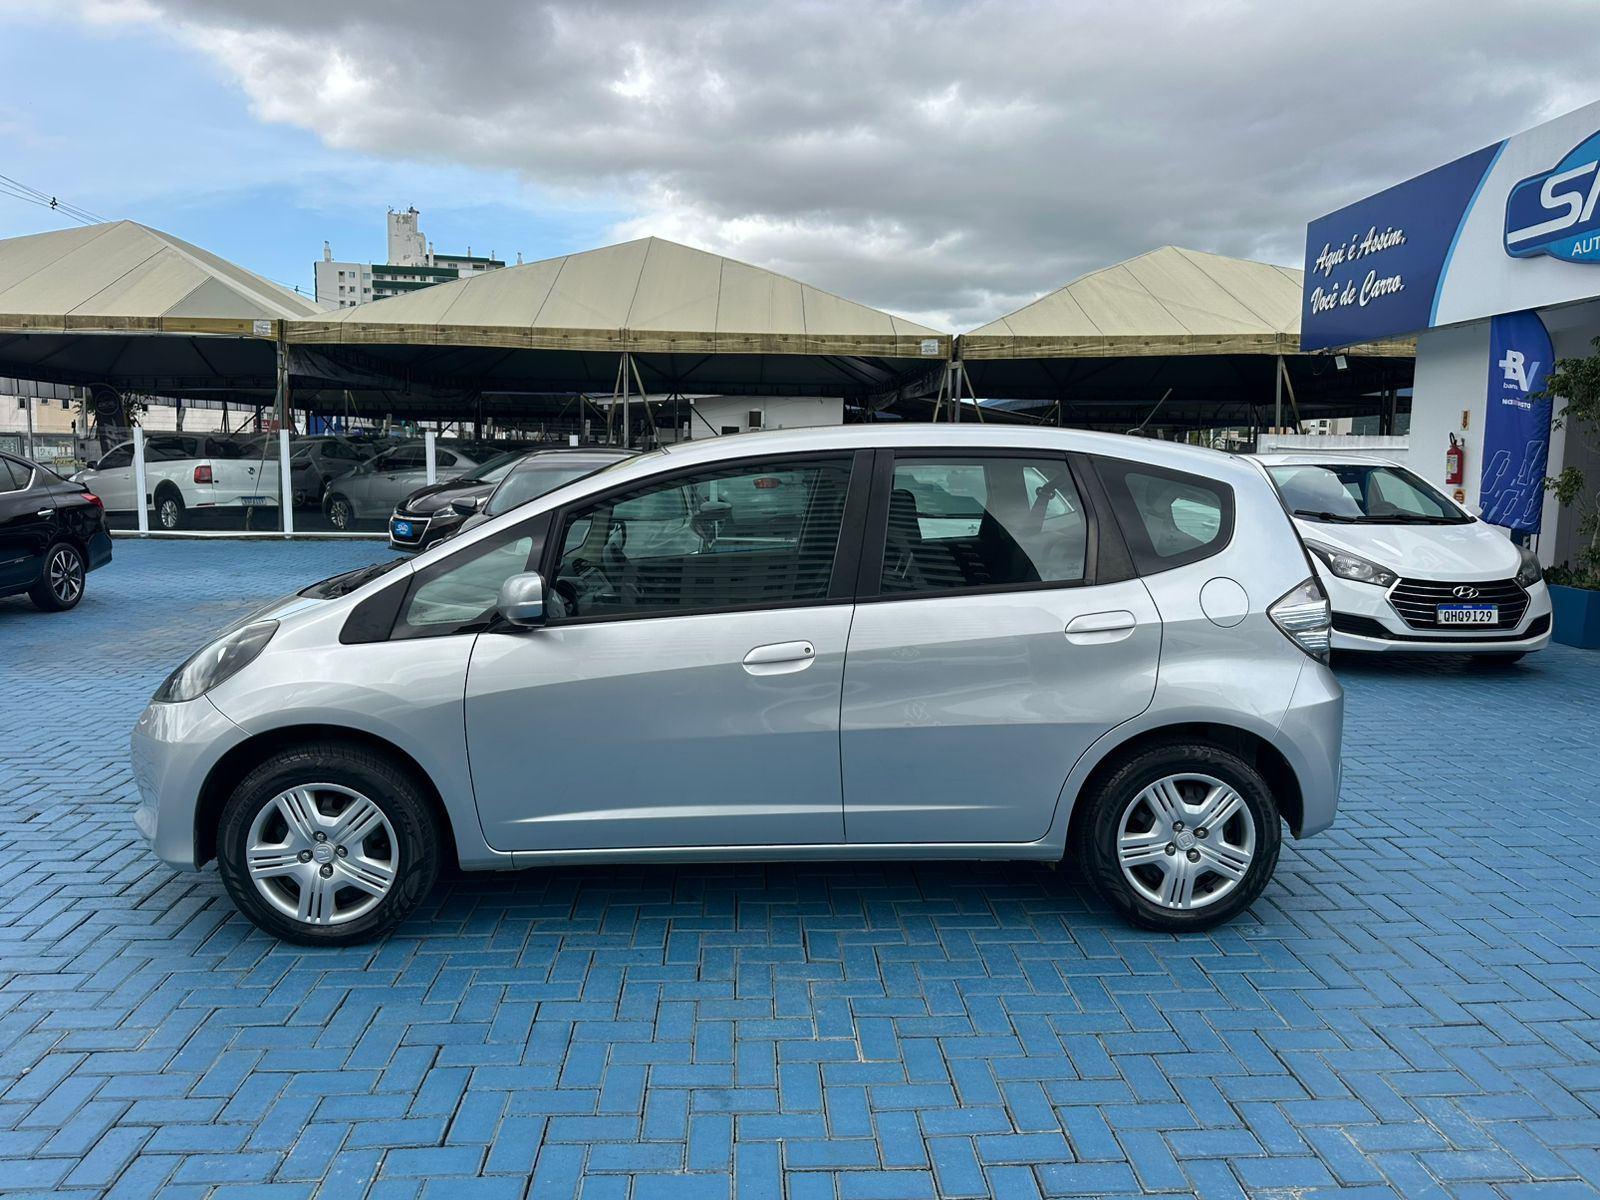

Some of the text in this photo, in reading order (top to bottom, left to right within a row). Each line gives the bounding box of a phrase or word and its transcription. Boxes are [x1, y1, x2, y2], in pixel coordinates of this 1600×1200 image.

[1313, 242, 1347, 277] Aqui
[1347, 233, 1359, 261] é
[1310, 282, 1339, 314] Você
[1340, 279, 1357, 306] de
[1443, 610, 1492, 623] QHQ9I29
